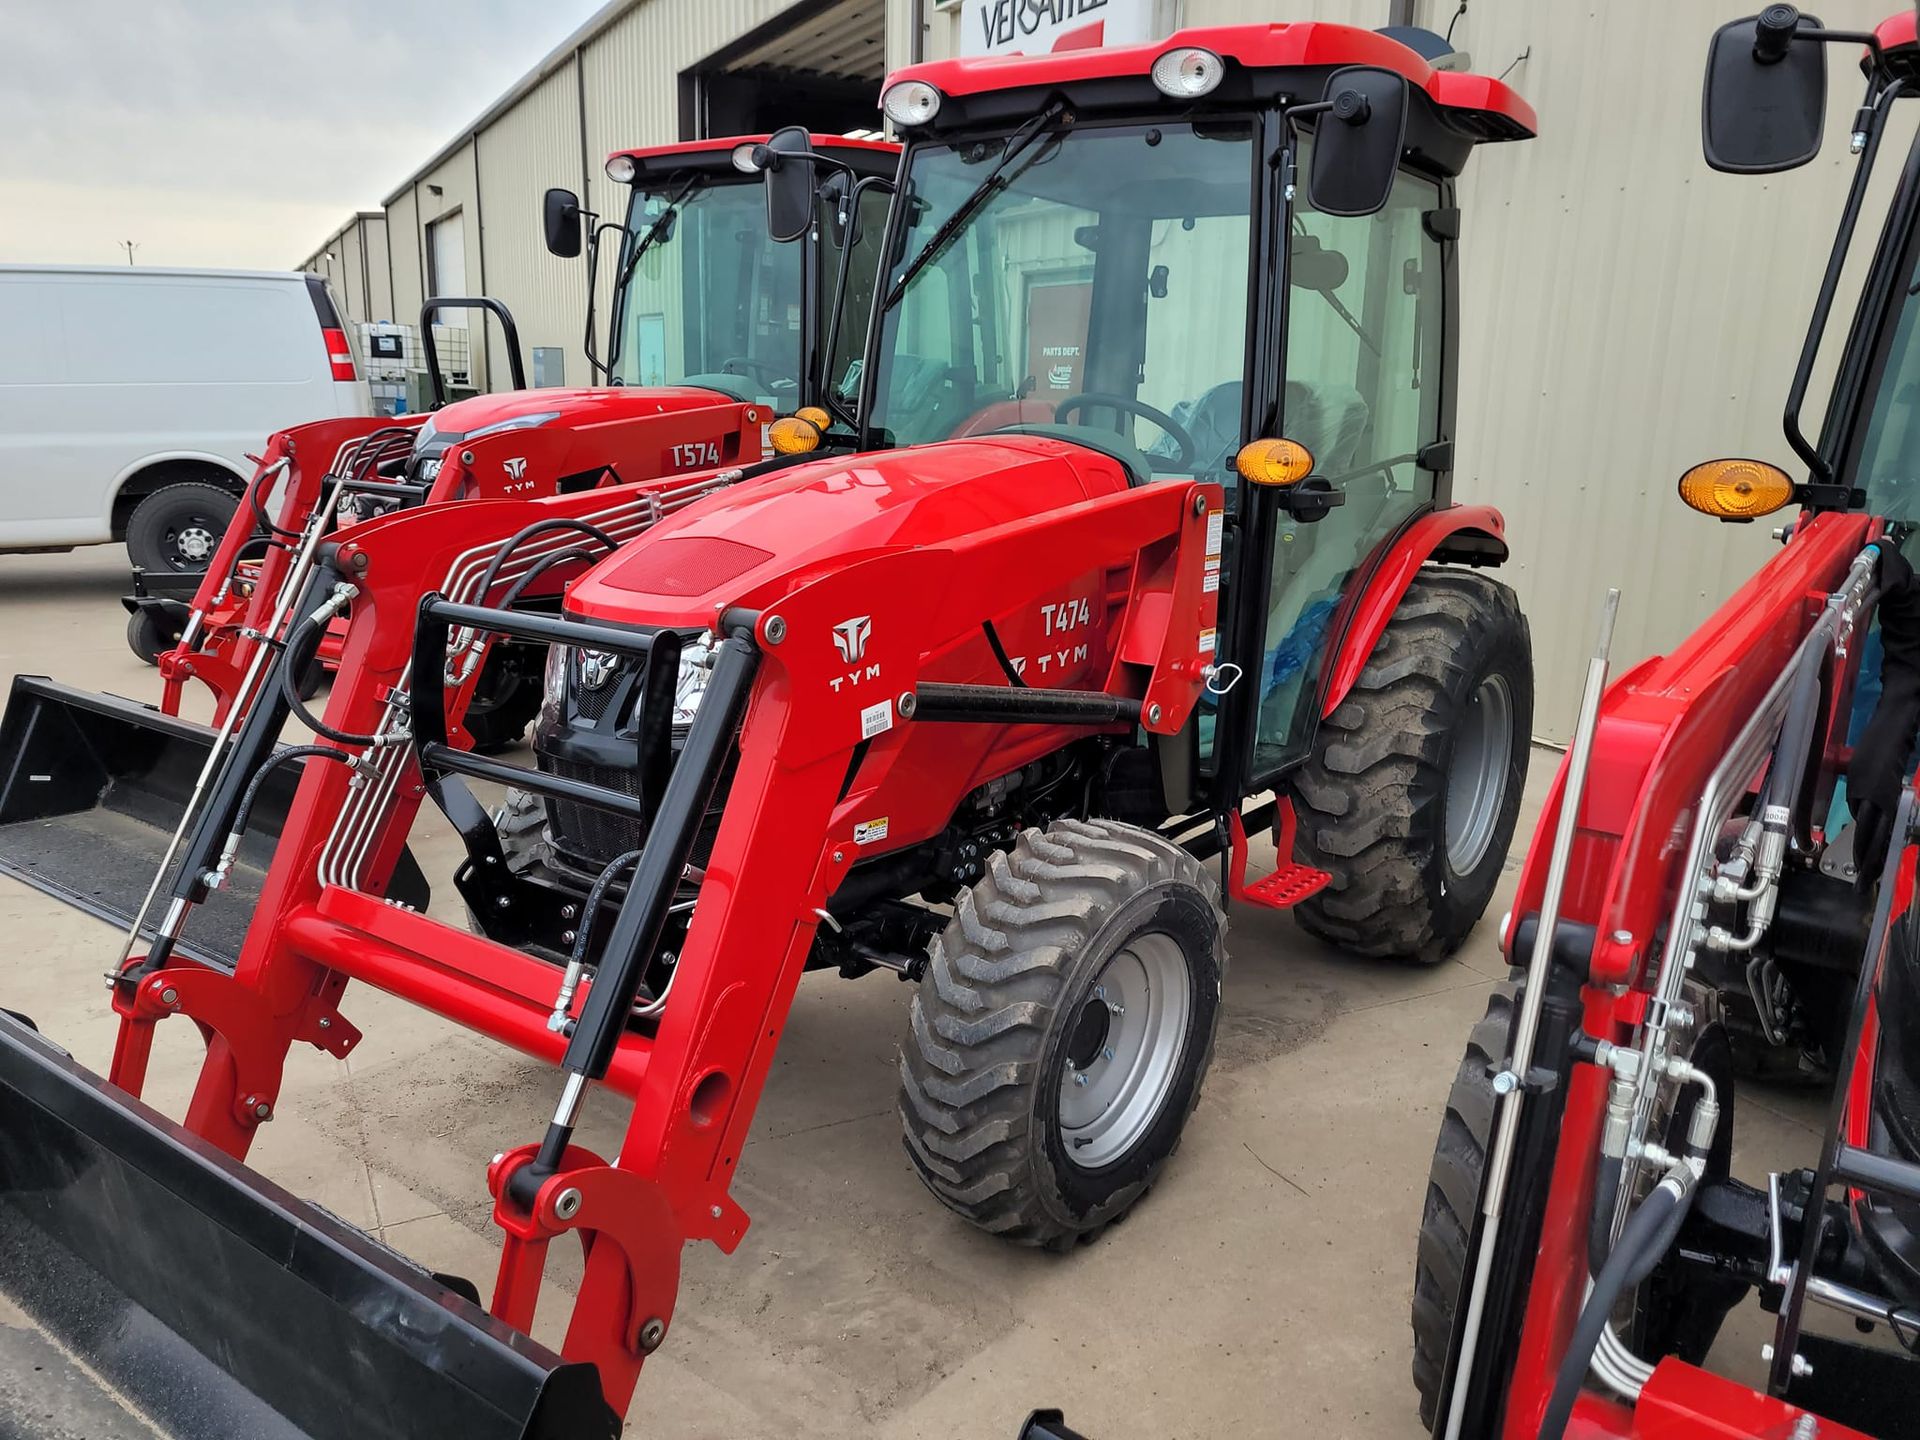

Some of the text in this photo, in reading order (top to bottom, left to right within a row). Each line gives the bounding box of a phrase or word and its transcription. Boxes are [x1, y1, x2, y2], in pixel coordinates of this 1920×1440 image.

[981, 0, 1107, 48] VERSAT
[1043, 346, 1061, 357] PARTS
[671, 443, 719, 467] T574
[504, 481, 534, 494] TYM
[1041, 597, 1090, 636] T474
[1038, 643, 1088, 673] TYM
[829, 663, 880, 693] TYM
